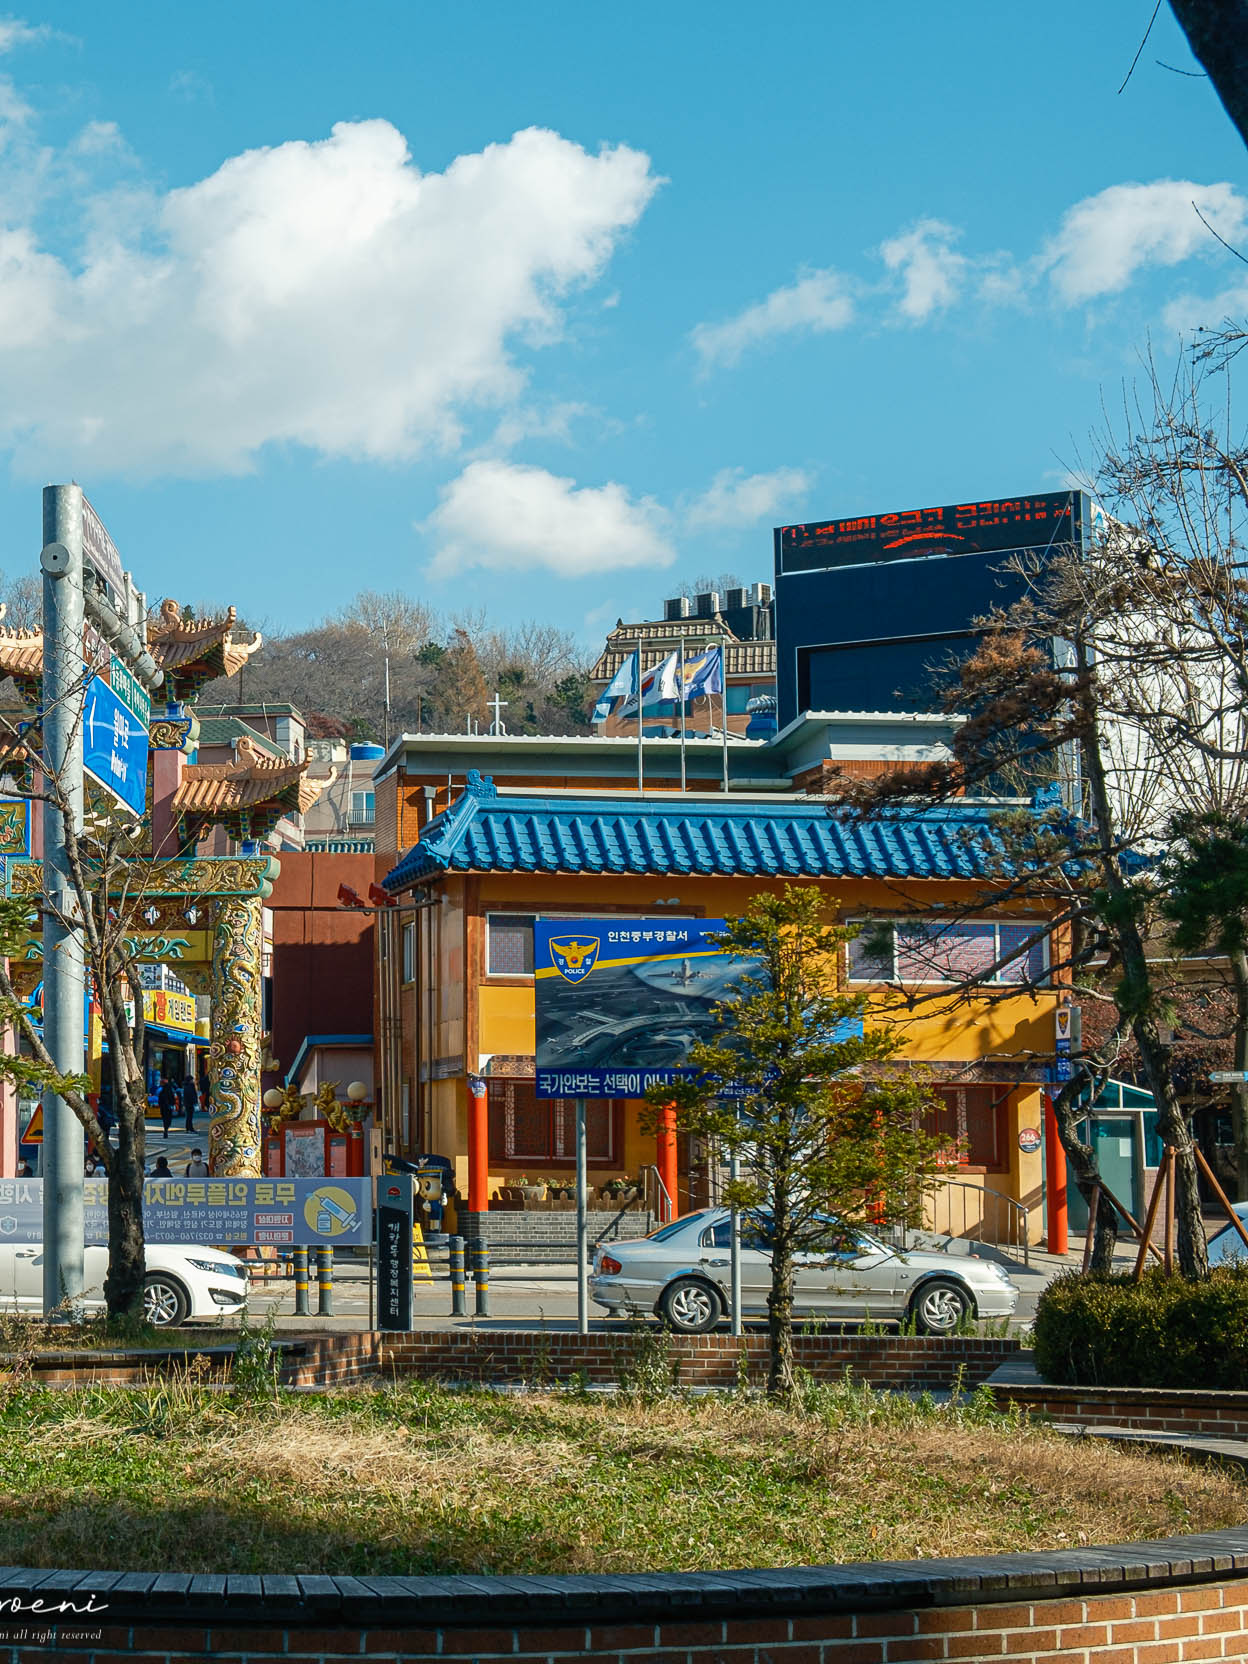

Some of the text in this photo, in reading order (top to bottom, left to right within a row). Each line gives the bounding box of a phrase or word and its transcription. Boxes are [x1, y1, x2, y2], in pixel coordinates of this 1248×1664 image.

[607, 930, 689, 943] 인천중부경찰서
[564, 967, 585, 975] POLICE
[168, 998, 193, 1024] 게임랜드
[539, 1074, 600, 1095] 국가안보는
[603, 1074, 640, 1094] 선택이
